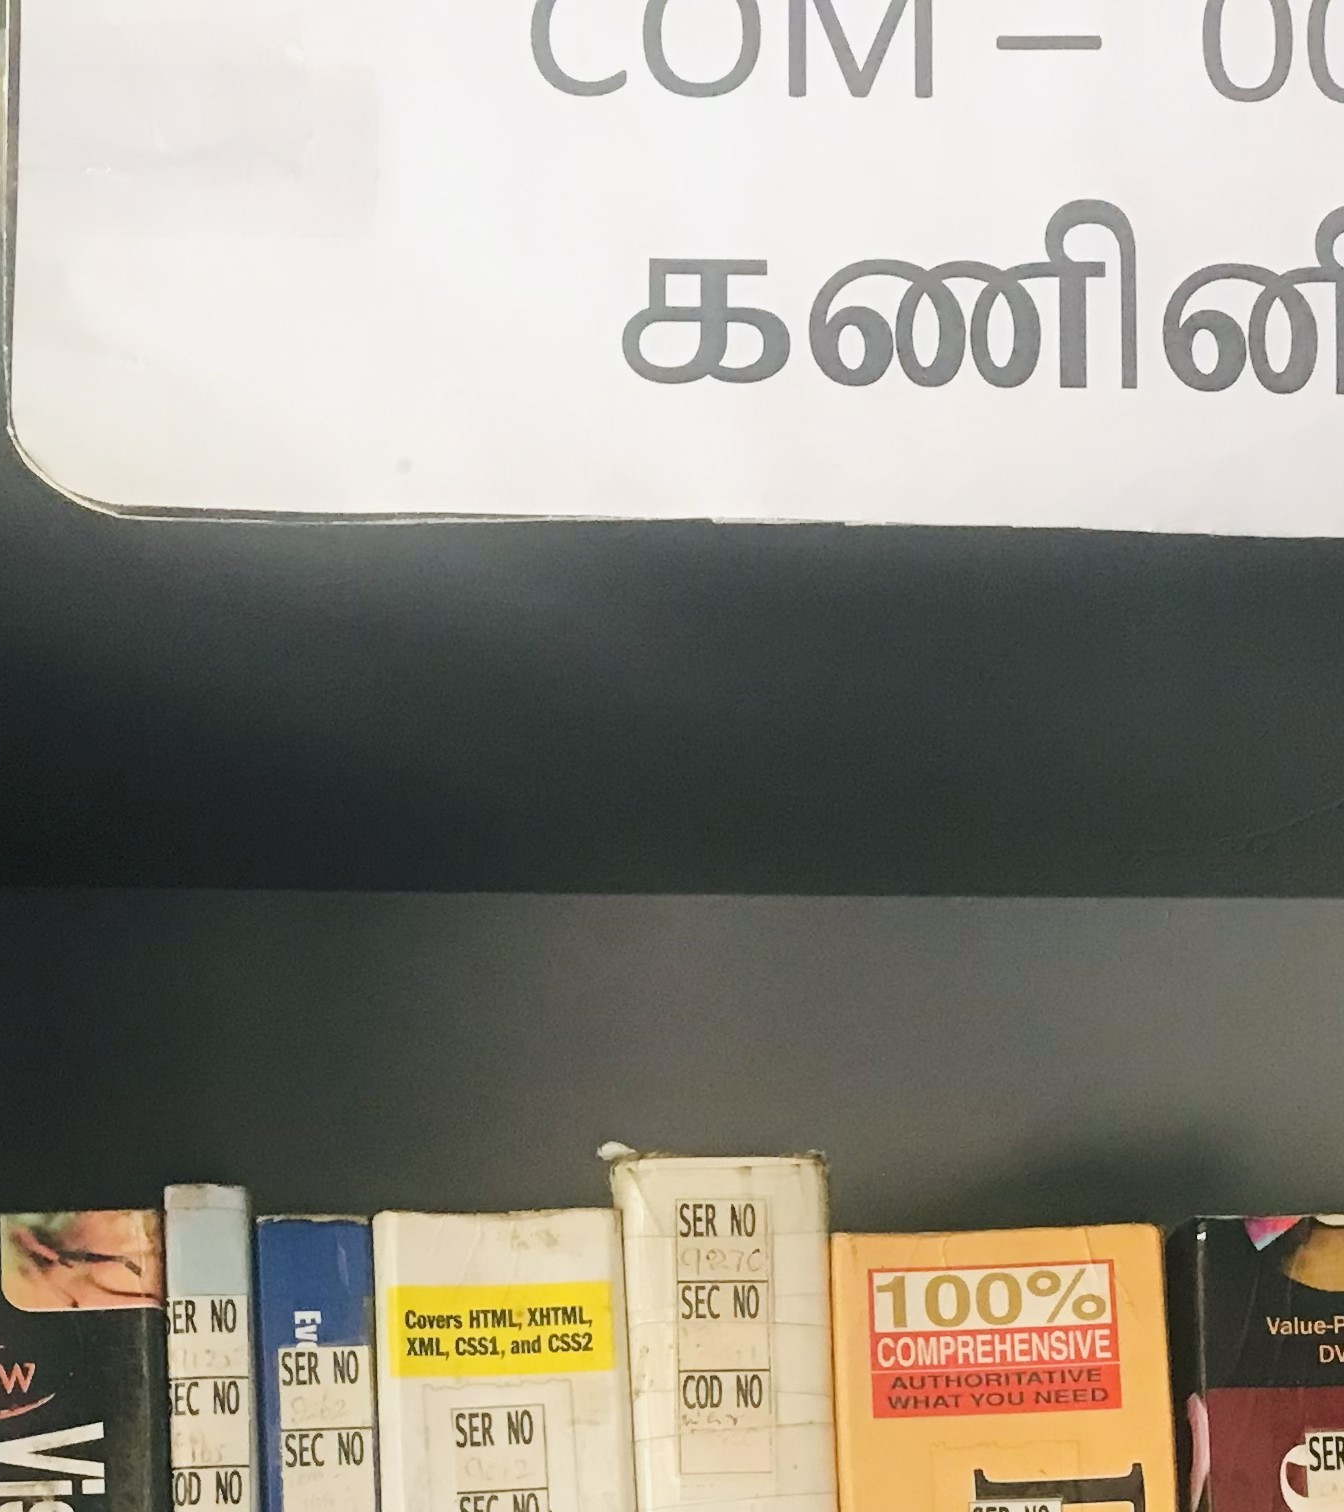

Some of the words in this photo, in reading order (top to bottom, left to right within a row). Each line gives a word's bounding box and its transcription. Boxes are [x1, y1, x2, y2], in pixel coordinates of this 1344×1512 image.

[530, 0, 933, 98] COM
[875, 1268, 1107, 1329] 100%
[405, 1309, 463, 1331] Covers
[469, 1308, 522, 1332] HTML,
[527, 1306, 594, 1329] XHTML,
[407, 1336, 448, 1359] XML,
[455, 1335, 505, 1359] CSS1,
[510, 1335, 542, 1355] and
[548, 1334, 594, 1352] CSS2
[877, 1330, 1112, 1366] COMPREHENSIVE
[890, 1368, 1102, 1390] AUTHORITATIVE
[887, 1392, 965, 1411] WHAT
[971, 1391, 1024, 1409] YOU
[1035, 1388, 1108, 1405] NEED
[456, 1411, 496, 1448] SER
[507, 1410, 534, 1445] NO
